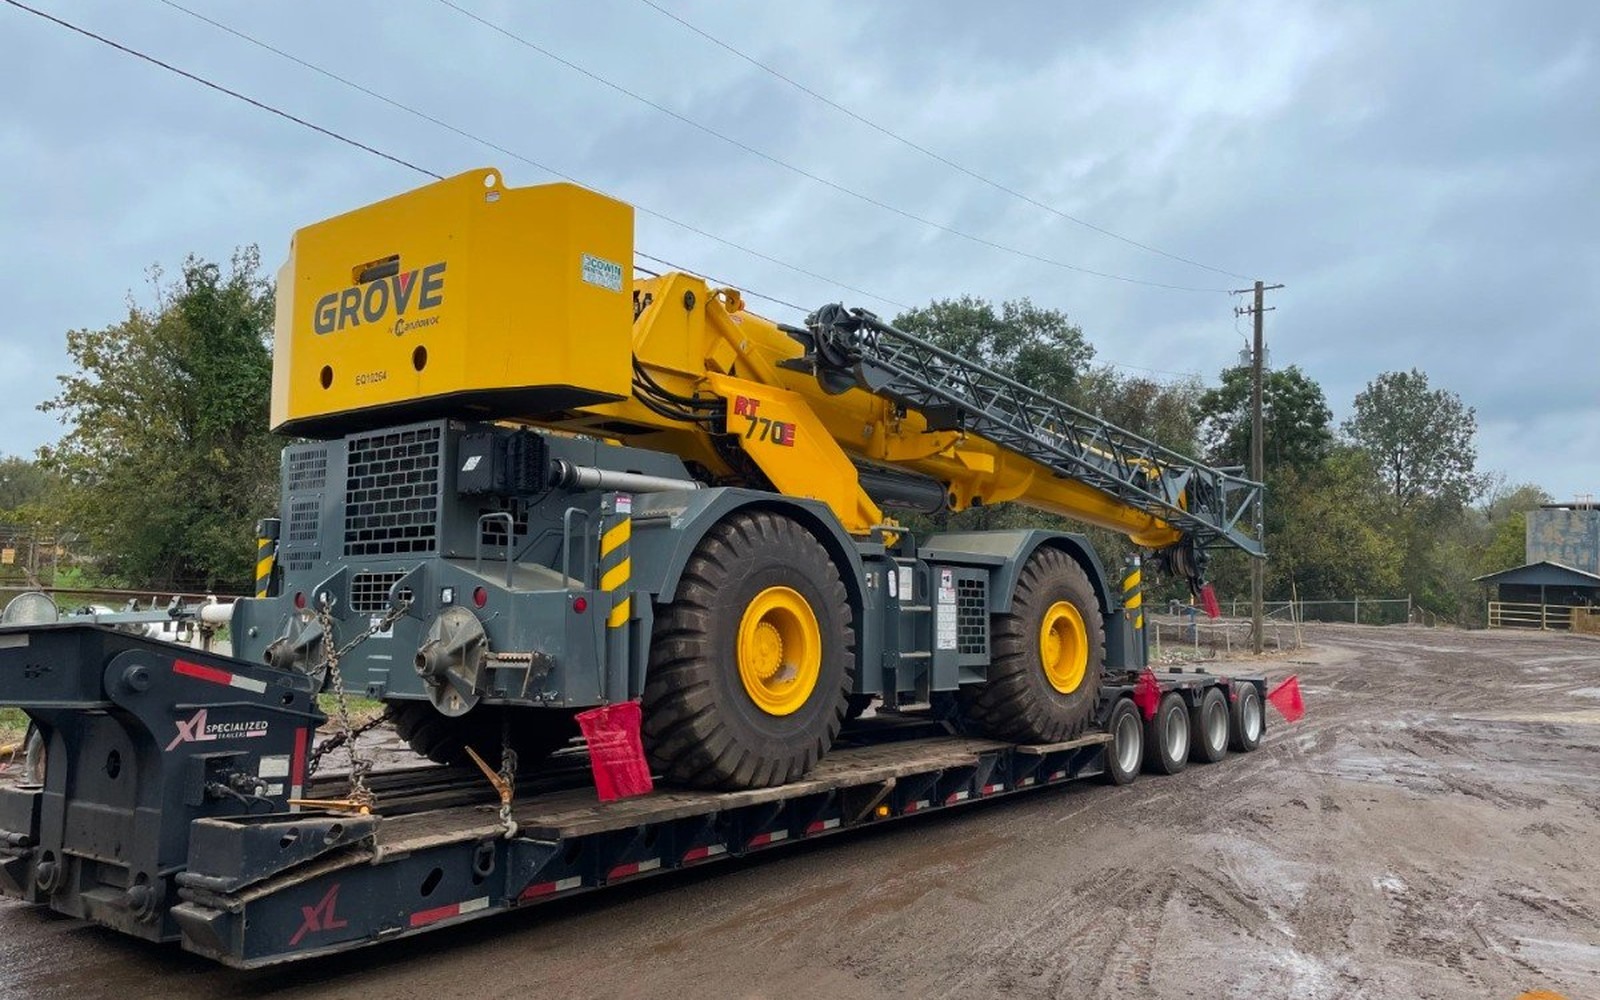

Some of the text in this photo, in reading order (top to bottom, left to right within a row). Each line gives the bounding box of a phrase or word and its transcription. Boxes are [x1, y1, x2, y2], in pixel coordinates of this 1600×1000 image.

[591, 258, 621, 276] COWIN
[314, 261, 447, 335] GROVE
[734, 395, 761, 416] RT
[745, 415, 797, 447] 770E
[206, 721, 269, 734] SPECIALIZED
[288, 883, 348, 946] XL
